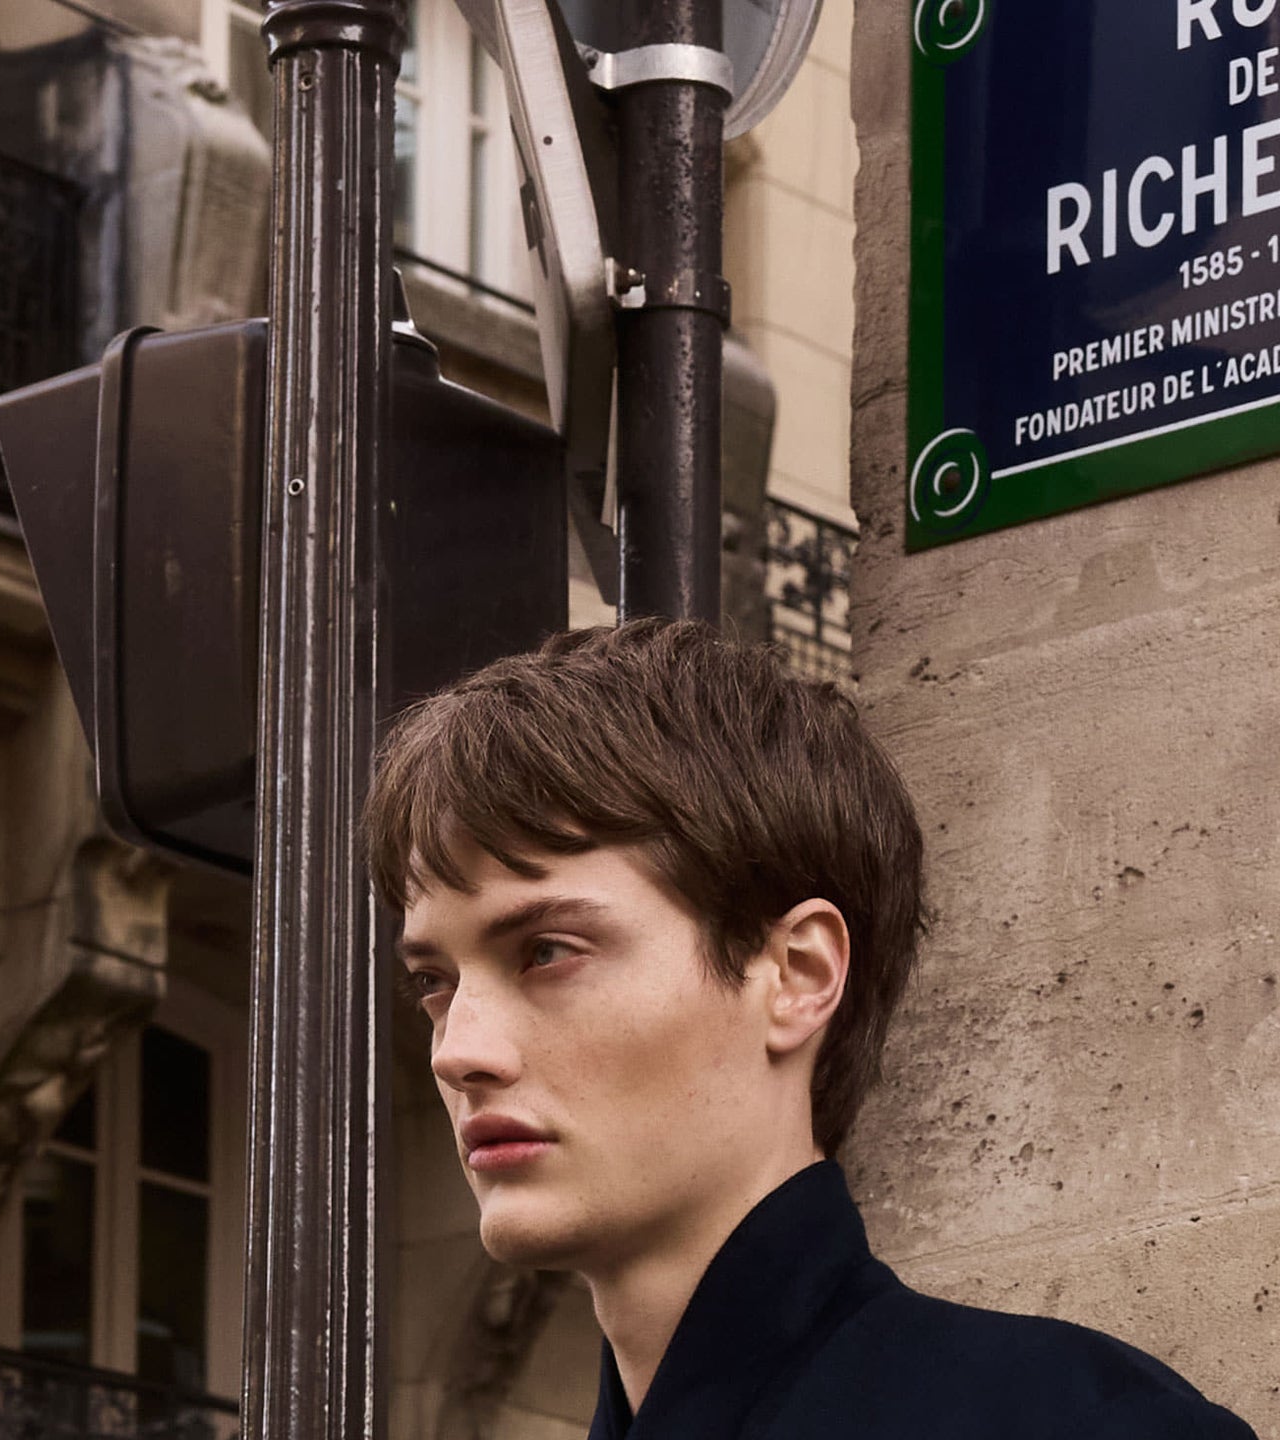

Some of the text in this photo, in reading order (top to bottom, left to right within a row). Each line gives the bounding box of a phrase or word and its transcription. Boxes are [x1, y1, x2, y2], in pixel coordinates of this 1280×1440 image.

[1228, 47, 1280, 106] DE
[1179, 244, 1244, 289] 1585
[1053, 323, 1165, 381] PREMIER
[1015, 381, 1156, 446] FONDATEUR
[1163, 369, 1195, 405] DE
